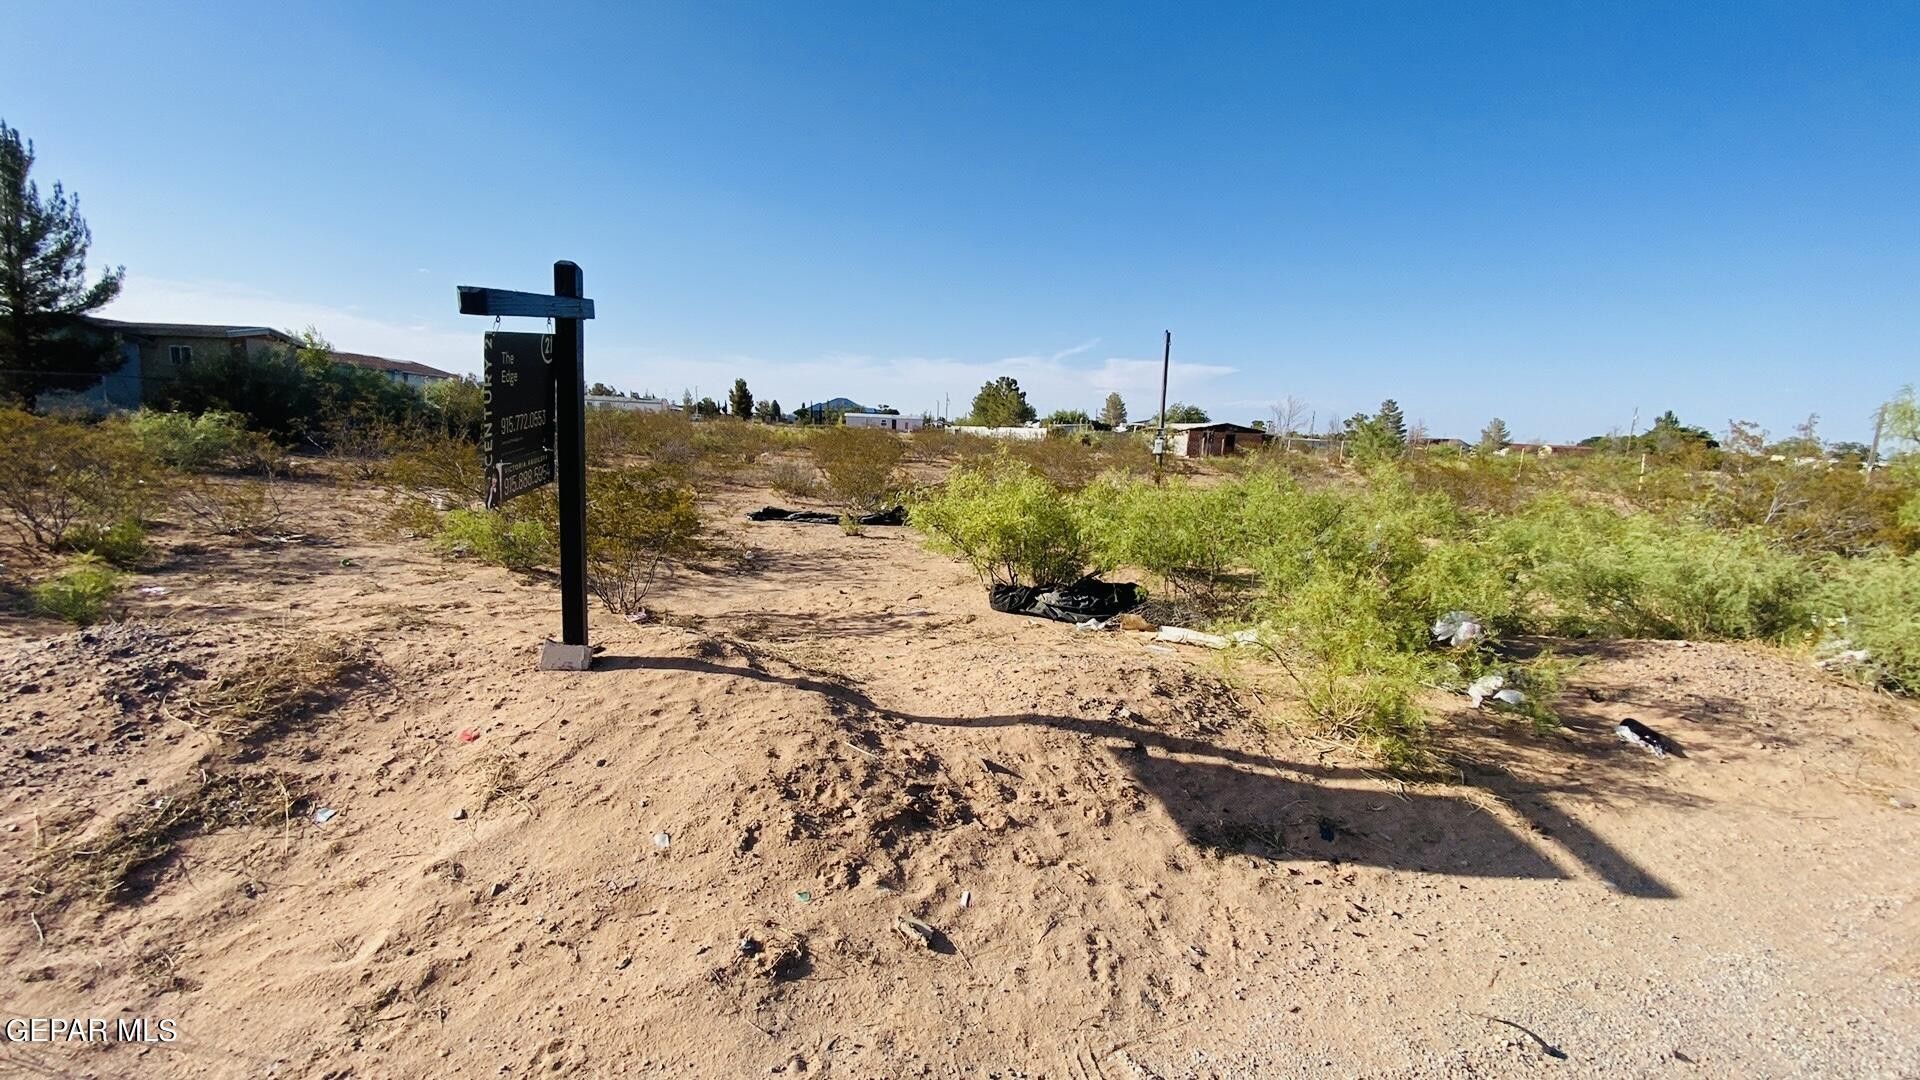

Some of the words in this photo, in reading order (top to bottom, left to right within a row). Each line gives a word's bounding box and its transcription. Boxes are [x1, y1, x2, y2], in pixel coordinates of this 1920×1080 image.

[501, 351, 515, 365] The
[501, 369, 518, 387] Edge
[484, 359, 493, 467] CENTURY
